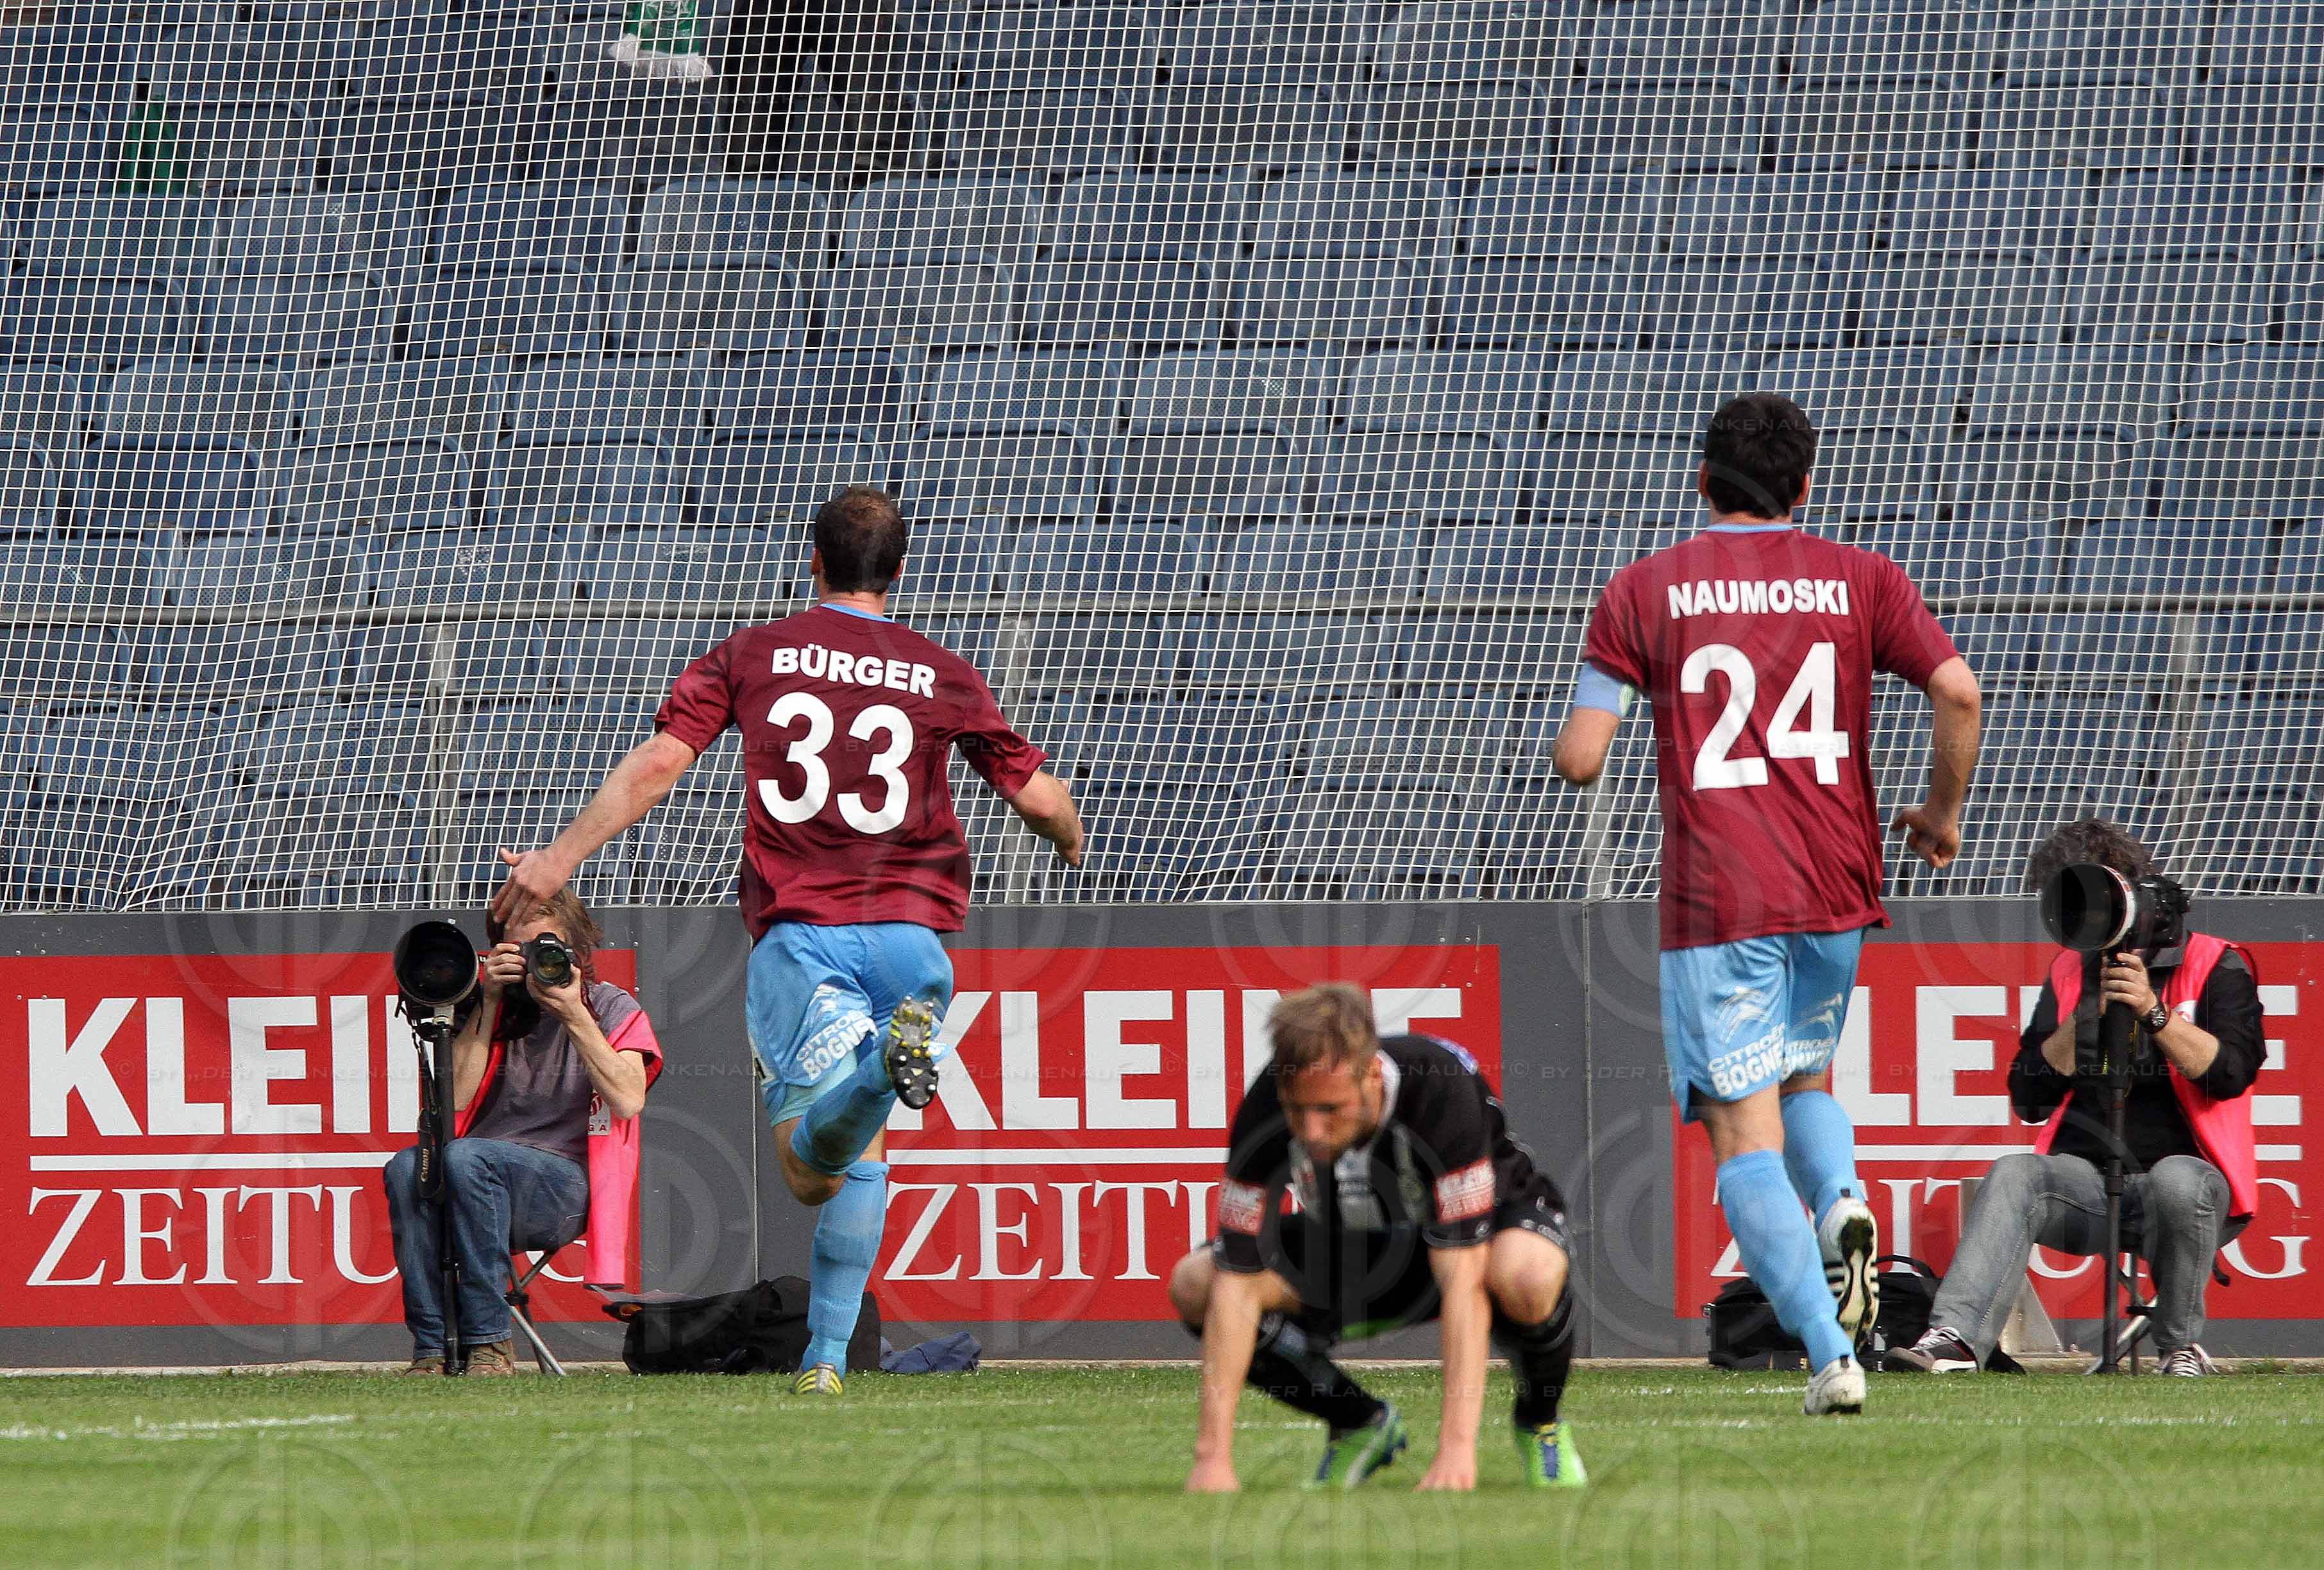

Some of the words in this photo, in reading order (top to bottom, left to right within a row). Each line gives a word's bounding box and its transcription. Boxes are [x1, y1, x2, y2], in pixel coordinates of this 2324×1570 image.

[1667, 578, 1849, 620] NAUMOSKI
[771, 643, 936, 699] BÜRGER
[1680, 641, 1850, 791] 24
[758, 691, 914, 834] 33
[28, 995, 435, 1137] KLEI
[886, 988, 1461, 1131] KLEI
[26, 1184, 585, 1287] ZEITU
[884, 1178, 1305, 1281] ZEIT
